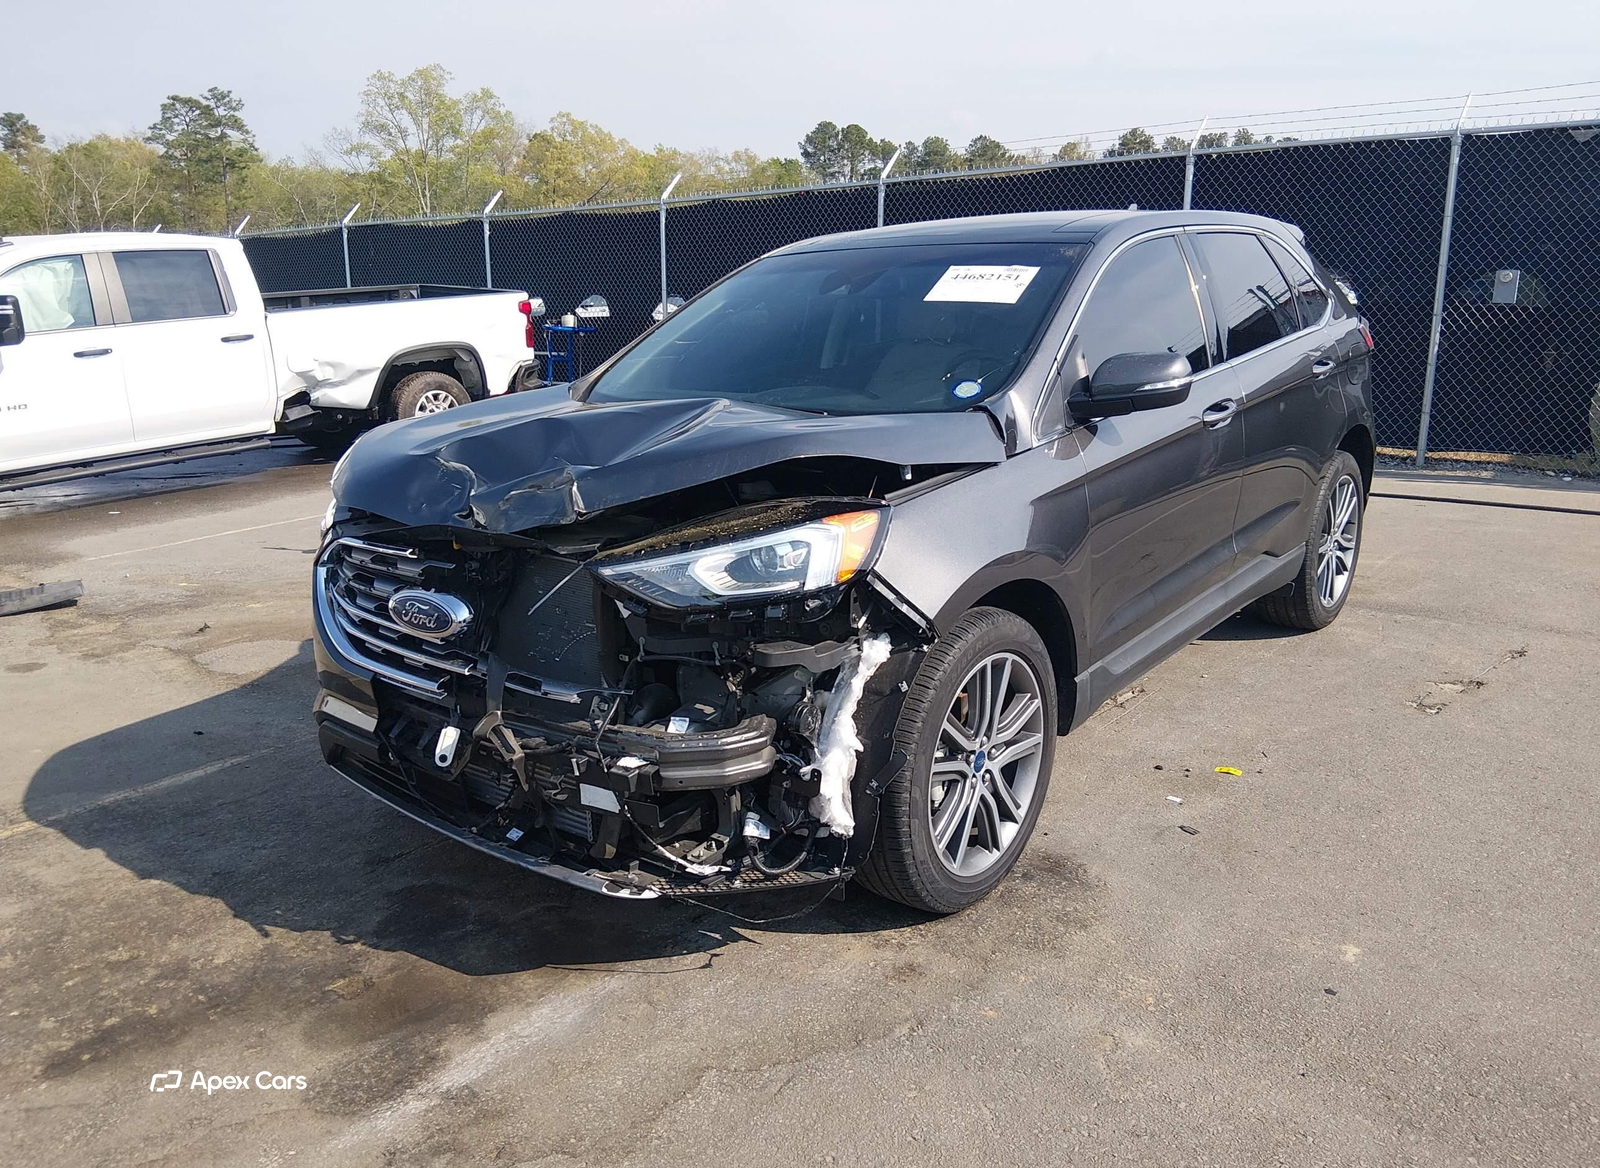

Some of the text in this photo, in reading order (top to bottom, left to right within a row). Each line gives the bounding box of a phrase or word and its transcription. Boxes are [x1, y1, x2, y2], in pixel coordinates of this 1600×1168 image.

[950, 272, 1021, 281] 44682151
[7, 403, 28, 411] HD
[401, 601, 439, 628] Ford
